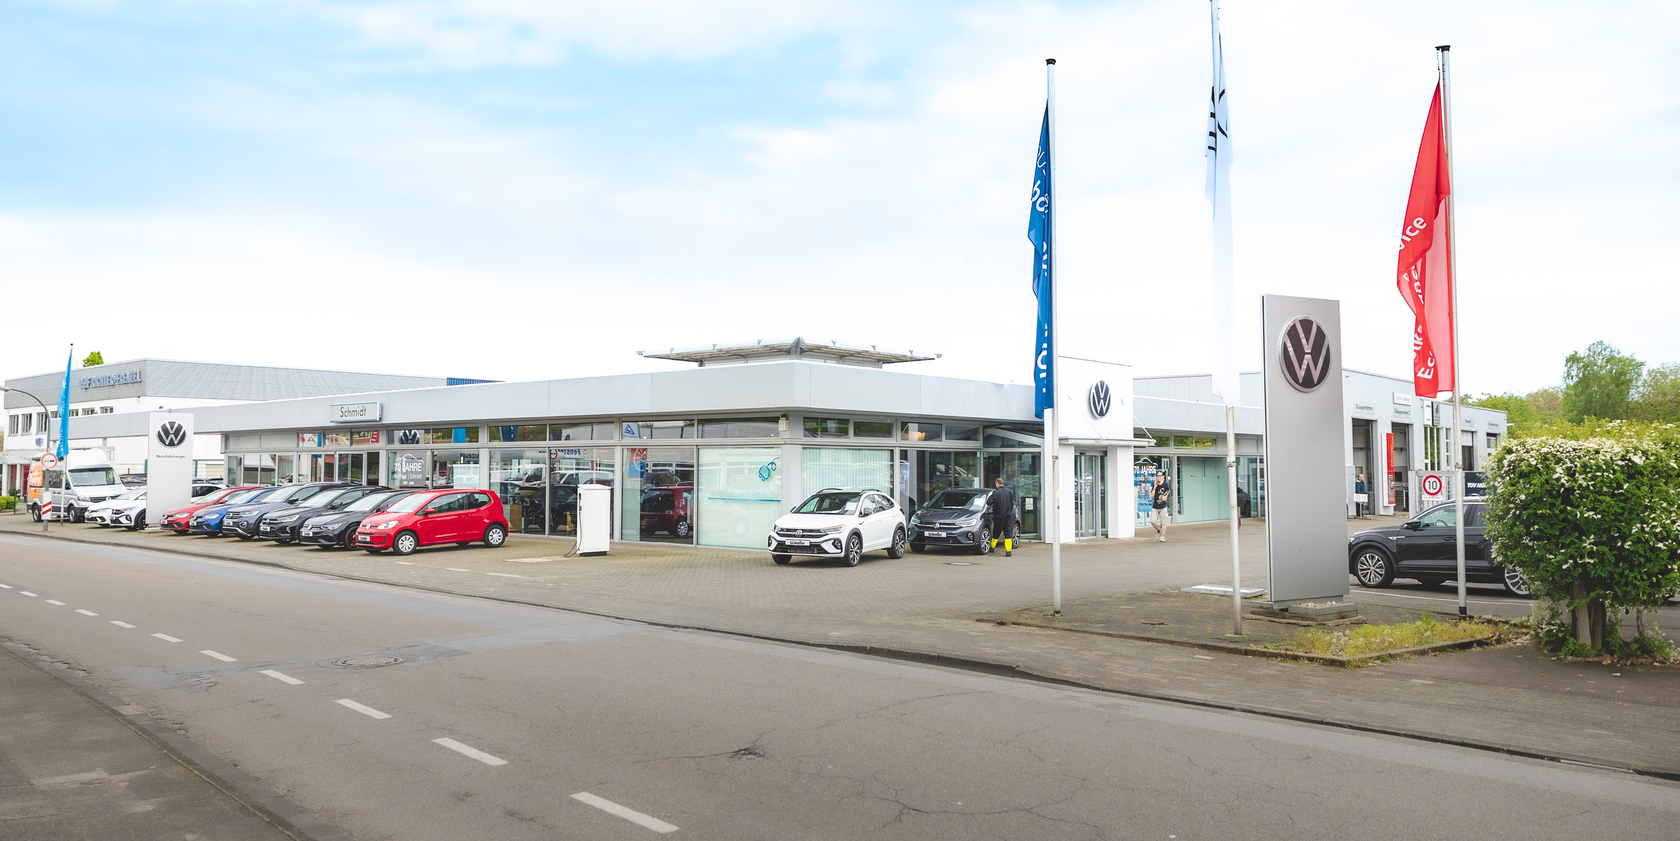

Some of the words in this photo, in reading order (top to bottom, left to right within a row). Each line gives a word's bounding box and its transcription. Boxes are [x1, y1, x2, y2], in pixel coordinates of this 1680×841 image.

[340, 405, 367, 418] Schmidt
[402, 462, 422, 472] JAHRE
[1427, 480, 1437, 490] 10
